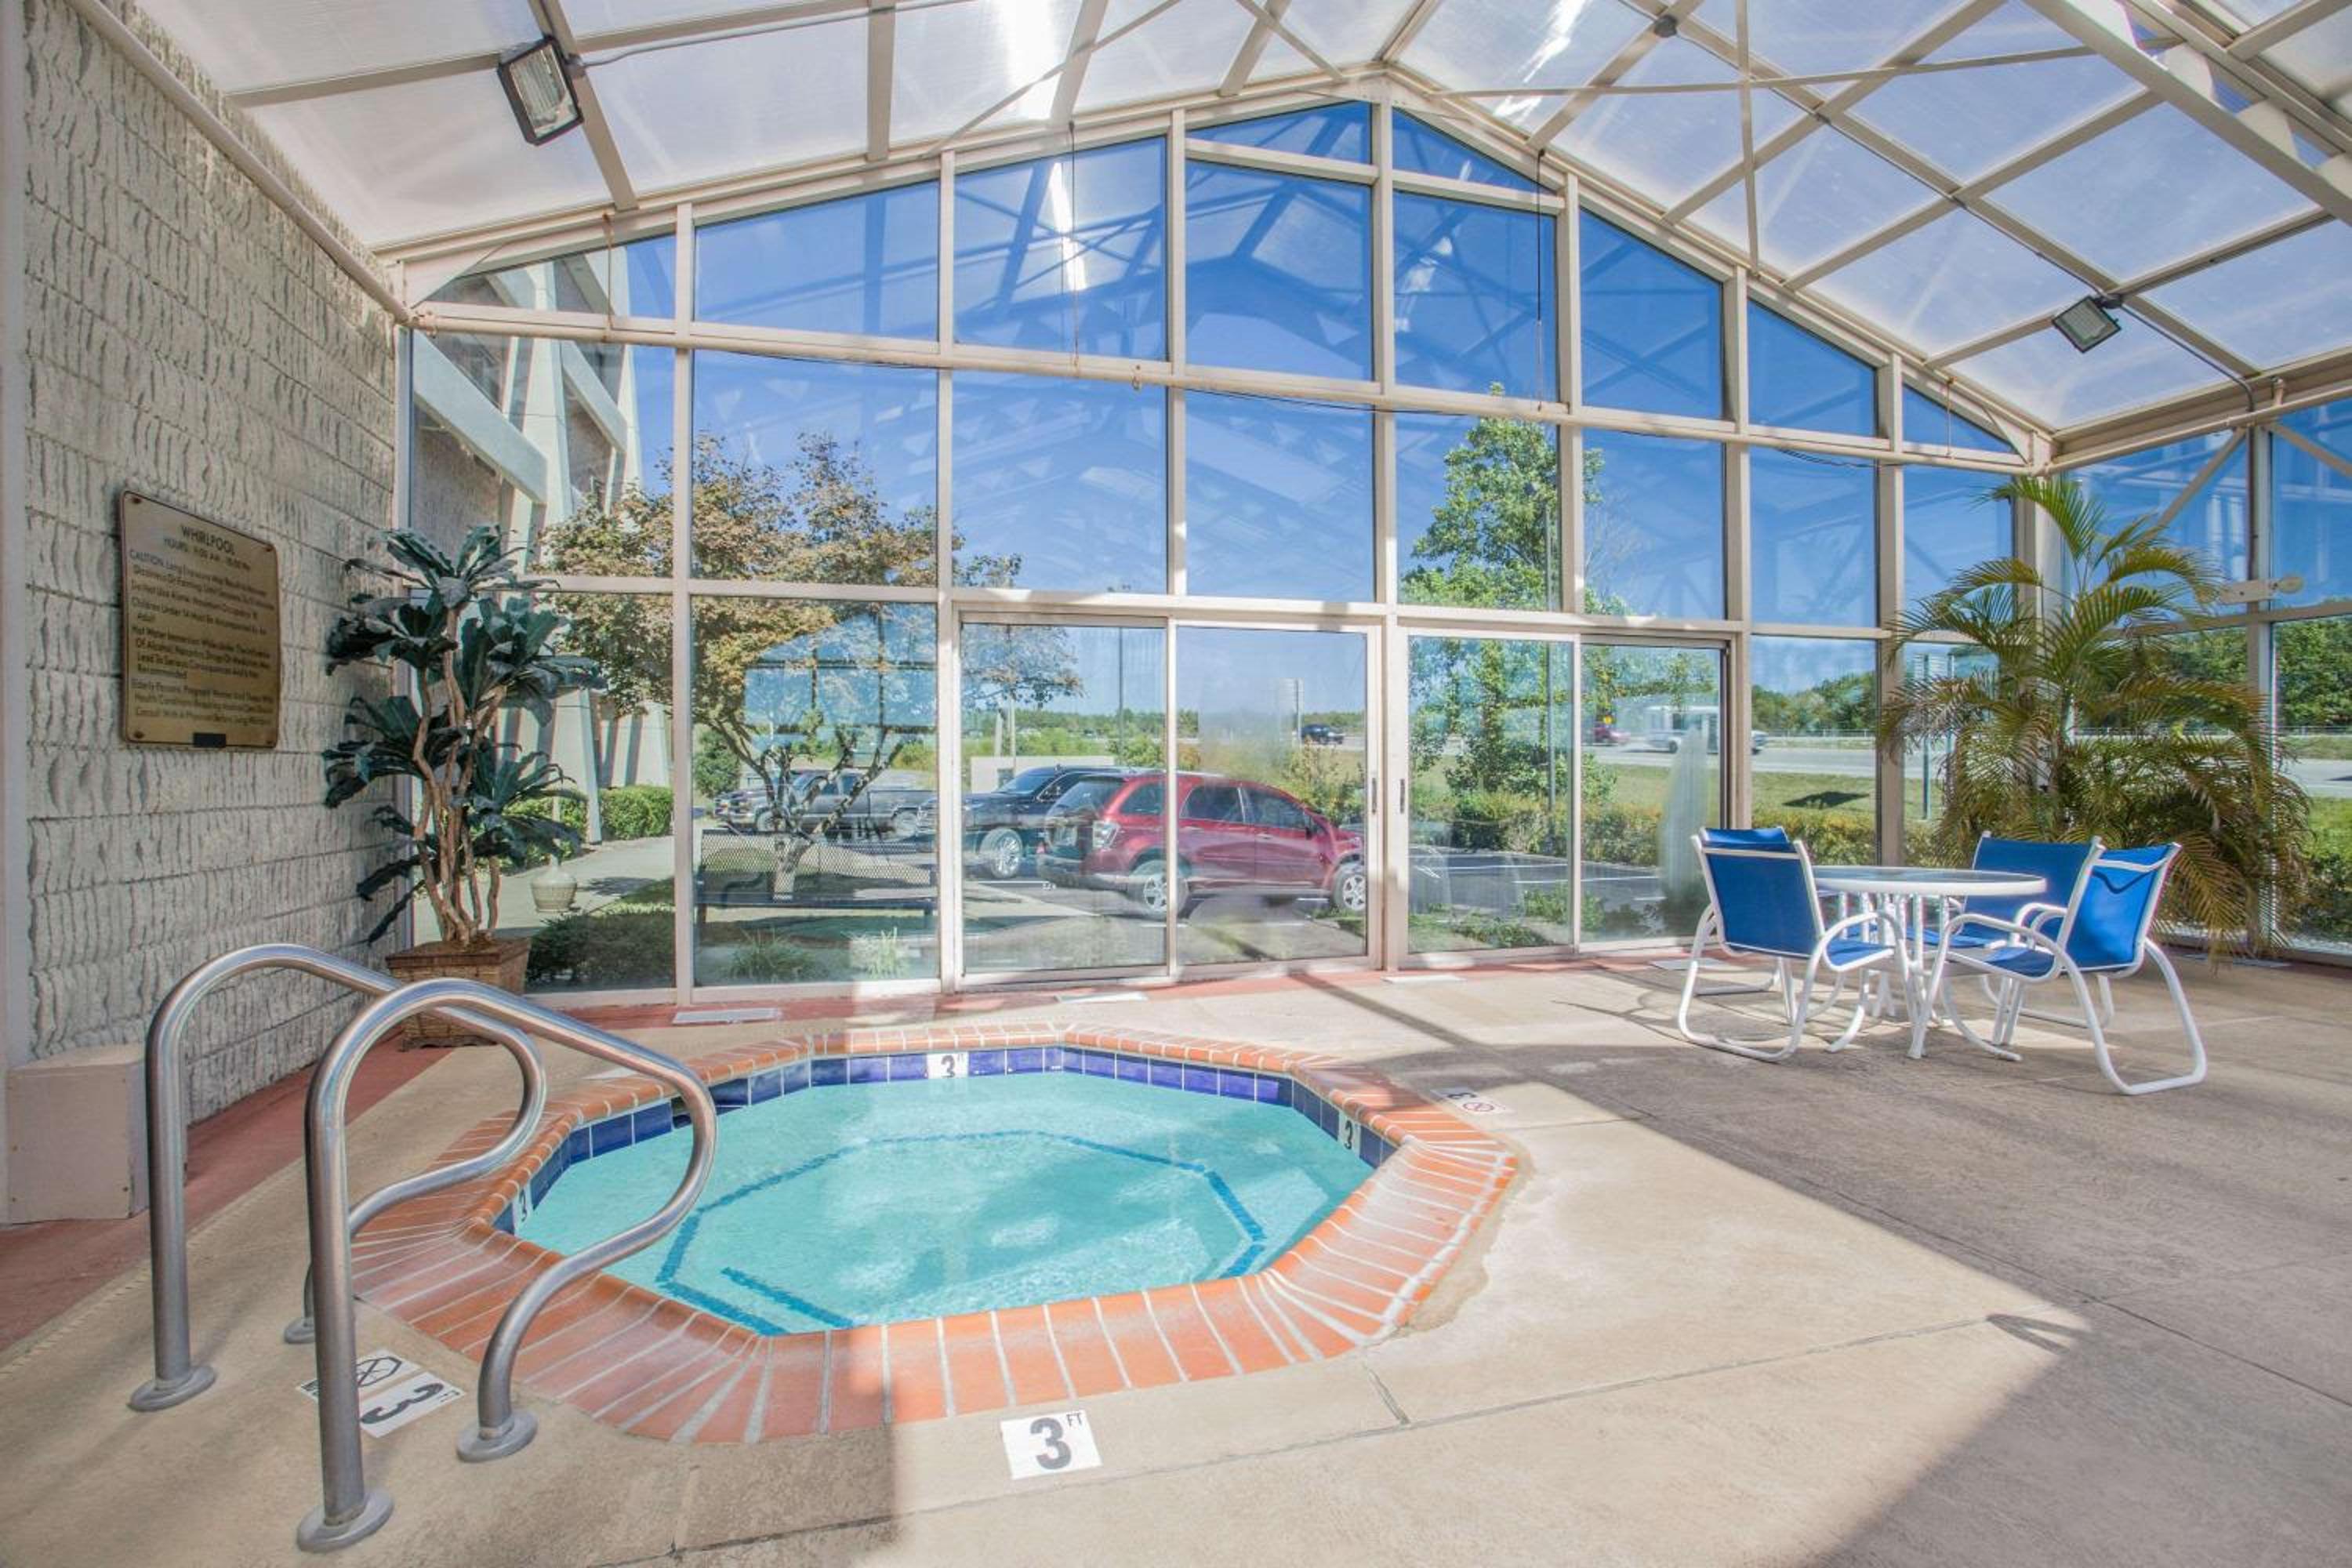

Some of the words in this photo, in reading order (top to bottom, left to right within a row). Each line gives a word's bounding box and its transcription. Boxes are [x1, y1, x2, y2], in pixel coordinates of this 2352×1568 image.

[180, 524, 236, 556] WHIRLPOOL
[1344, 1120, 1353, 1150] 3
[360, 1382, 445, 1425] 3
[1029, 1417, 1072, 1470] 3
[1065, 1412, 1083, 1427] FT
